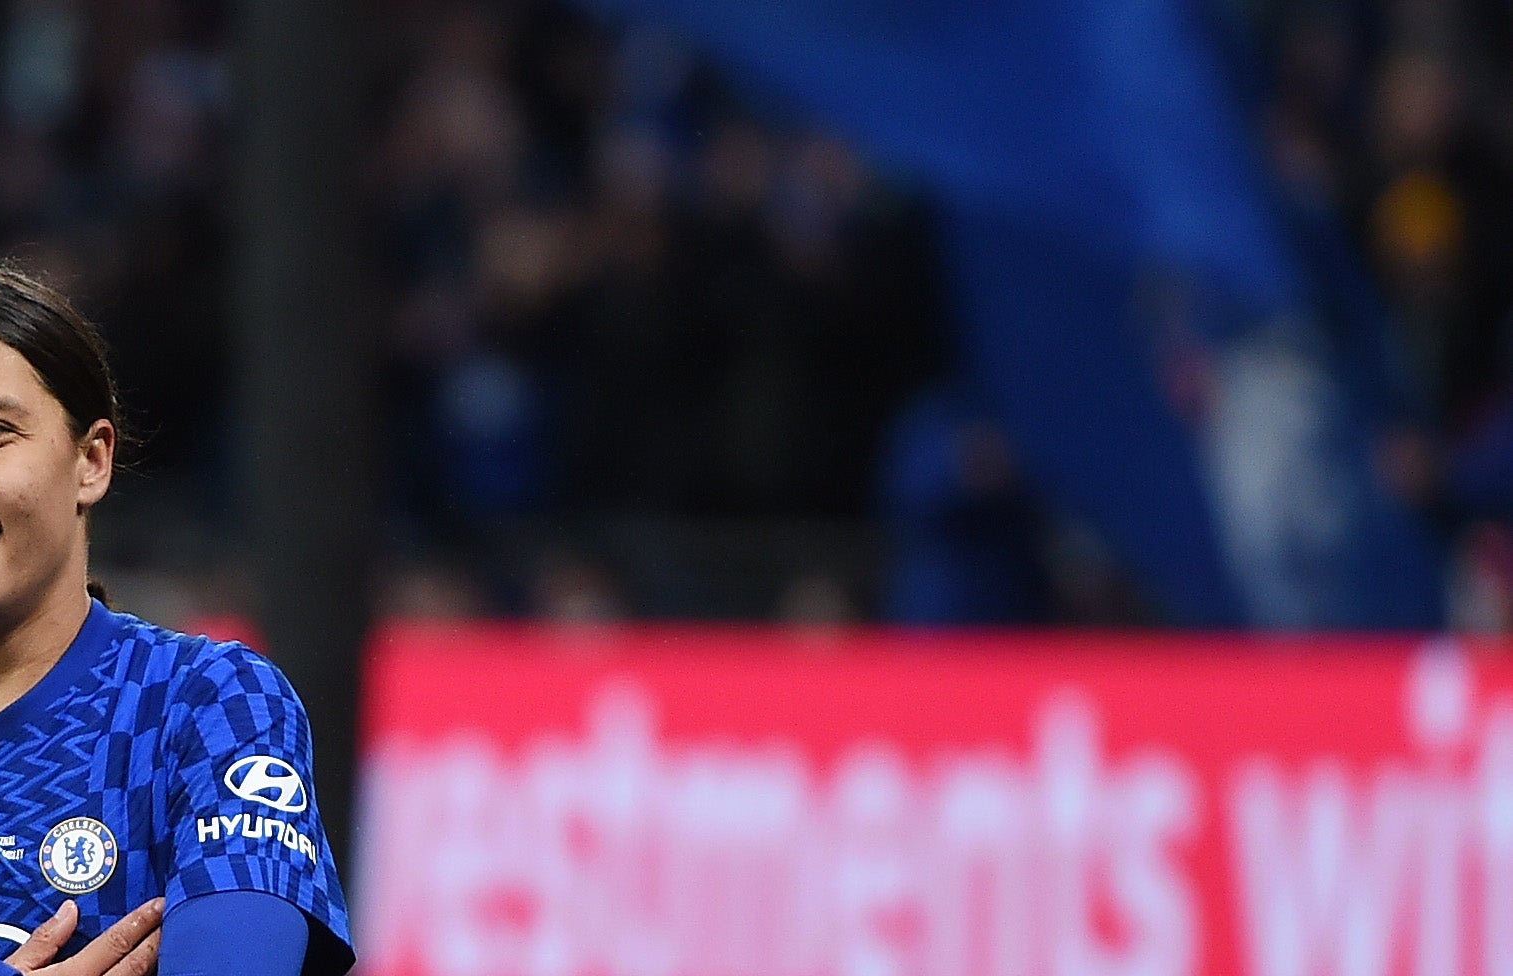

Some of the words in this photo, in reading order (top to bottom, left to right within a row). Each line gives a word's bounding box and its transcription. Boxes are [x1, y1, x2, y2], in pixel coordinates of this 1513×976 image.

[53, 820, 102, 838] CHELSEA
[197, 813, 316, 865] HYUNDAI
[53, 875, 87, 890] FOOTBALL
